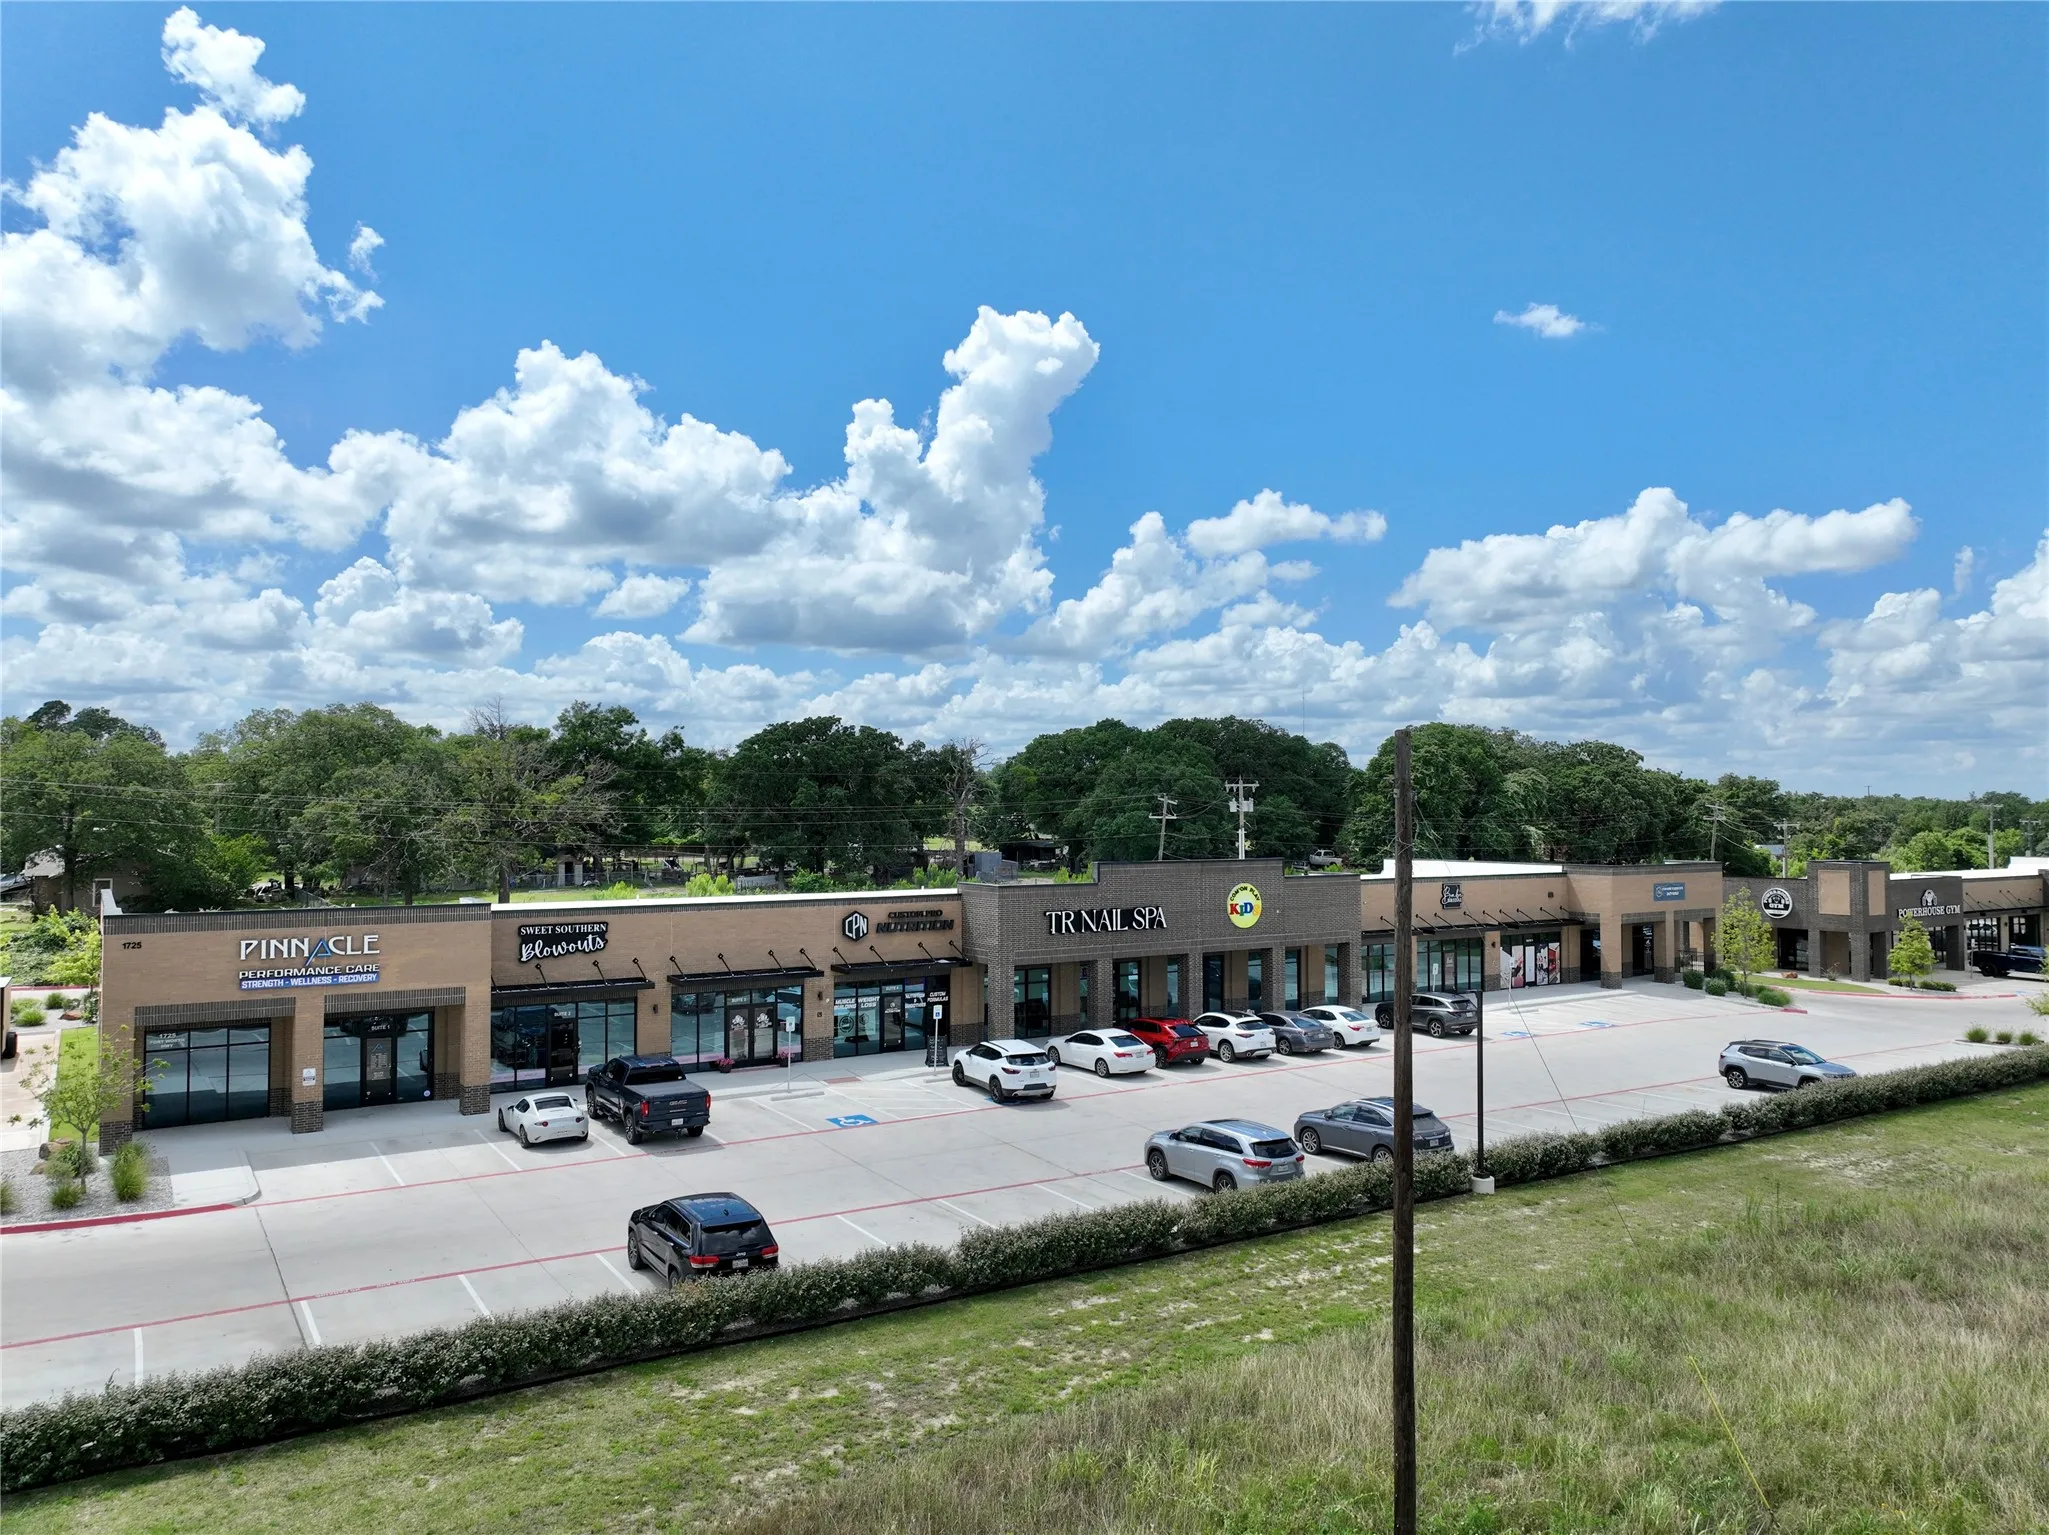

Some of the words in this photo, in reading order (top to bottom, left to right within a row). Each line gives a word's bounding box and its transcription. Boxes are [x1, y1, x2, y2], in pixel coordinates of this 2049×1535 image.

[1249, 888, 1260, 900] PLAY
[888, 911, 924, 919] CUSTOM
[925, 910, 943, 918] PRO
[1229, 902, 1260, 916] KIDS
[1946, 905, 1960, 914] GYM
[845, 912, 867, 939] CPN
[876, 919, 954, 933] NUTRITION
[1045, 910, 1075, 934] TR
[1081, 908, 1128, 932] NAIL
[1132, 907, 1167, 930] SPA
[520, 926, 553, 935] SWEET
[555, 923, 607, 934] SOUTHERN
[240, 934, 380, 967] PINNACLE
[520, 934, 606, 961] Blowouts
[239, 965, 342, 979] PERFORMANCE
[346, 963, 380, 973] CARE
[241, 978, 284, 989] STRENGTH
[290, 975, 332, 986] WELLNESS
[338, 973, 377, 983] RECOVERY
